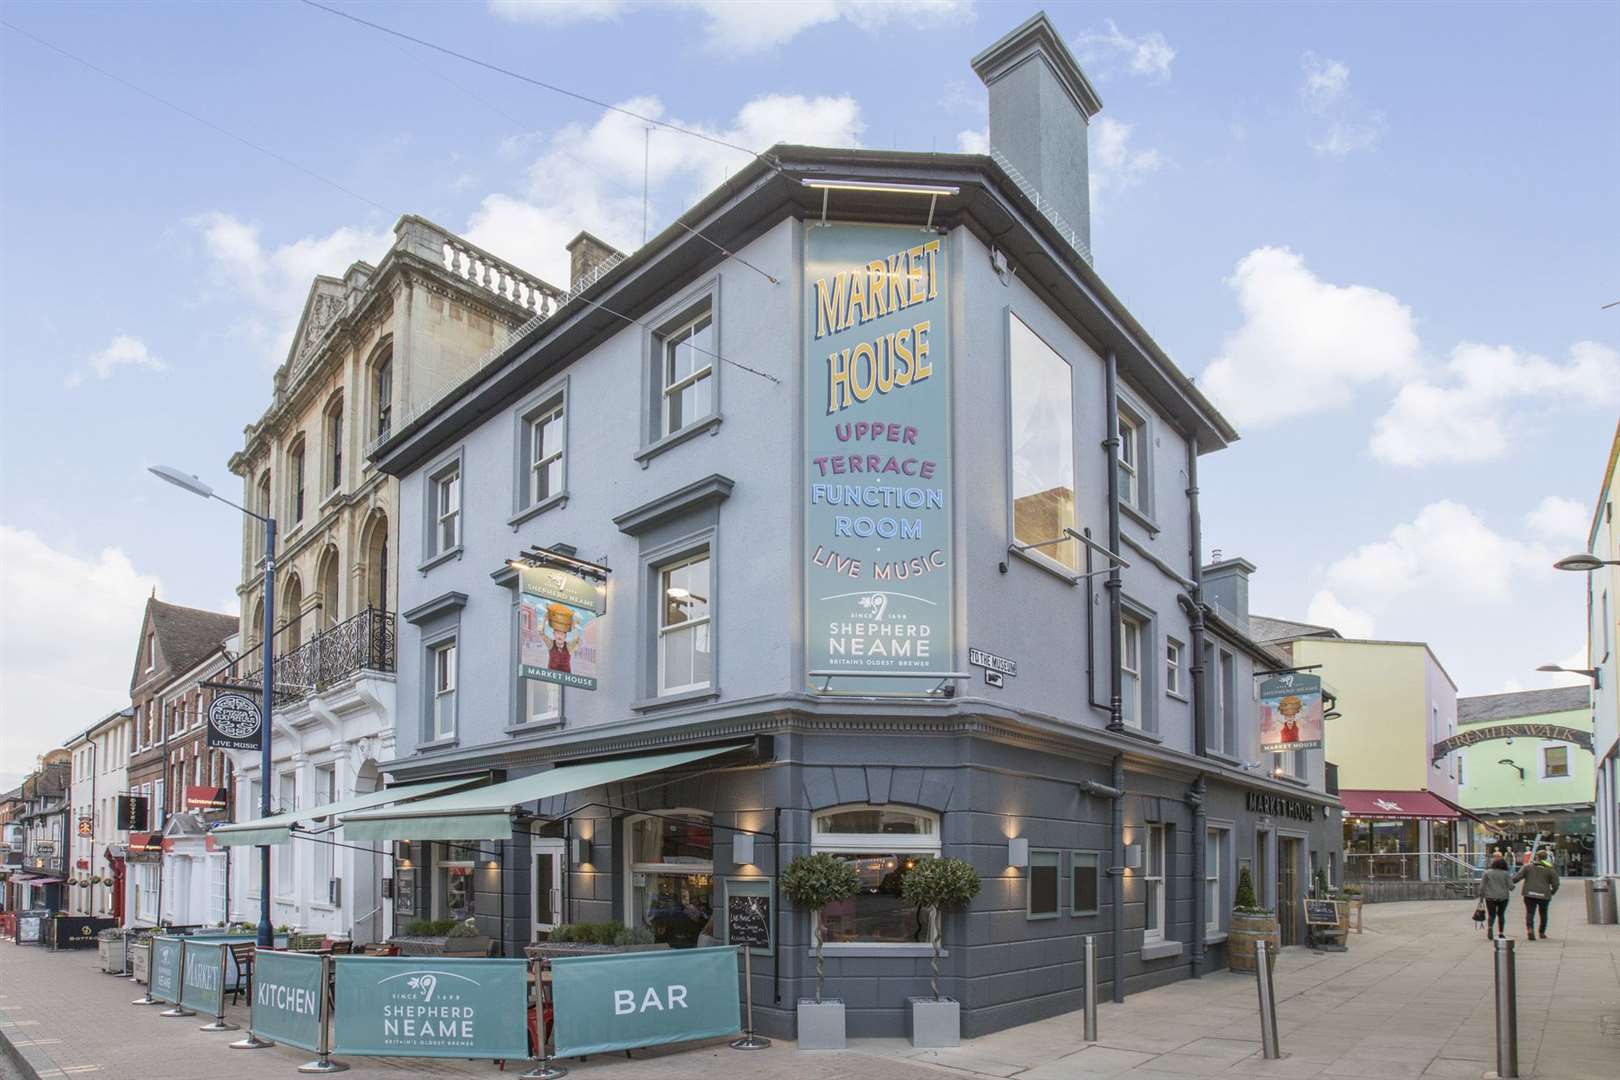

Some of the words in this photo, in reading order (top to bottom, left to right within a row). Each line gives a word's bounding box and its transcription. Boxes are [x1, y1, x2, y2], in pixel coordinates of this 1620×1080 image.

[815, 240, 940, 341] MARKET
[826, 320, 932, 416] HOUSE
[835, 422, 918, 445] UPPER
[813, 454, 937, 480] TERRACE
[812, 484, 943, 510] FUNCTION
[834, 515, 922, 540] ROOM
[812, 545, 861, 578] LIVE
[873, 549, 945, 580] MUSIC
[829, 622, 931, 637] SHEPHERD
[829, 638, 930, 657] NEAME
[528, 667, 562, 680] MARKET
[565, 674, 593, 687] HOUSE
[1264, 743, 1292, 751] MARKET
[1293, 741, 1318, 749] HOUSE
[1446, 725, 1519, 749] FREMLIN
[1523, 724, 1577, 741] WALK
[1246, 791, 1286, 817] MARKET
[1286, 800, 1314, 822] HOUSE
[186, 951, 218, 991] MARKET
[257, 982, 315, 1016] KITCHEN
[383, 1005, 474, 1018] SHEPHERD
[614, 984, 688, 1015] BAR
[384, 1019, 473, 1038] NEAME
